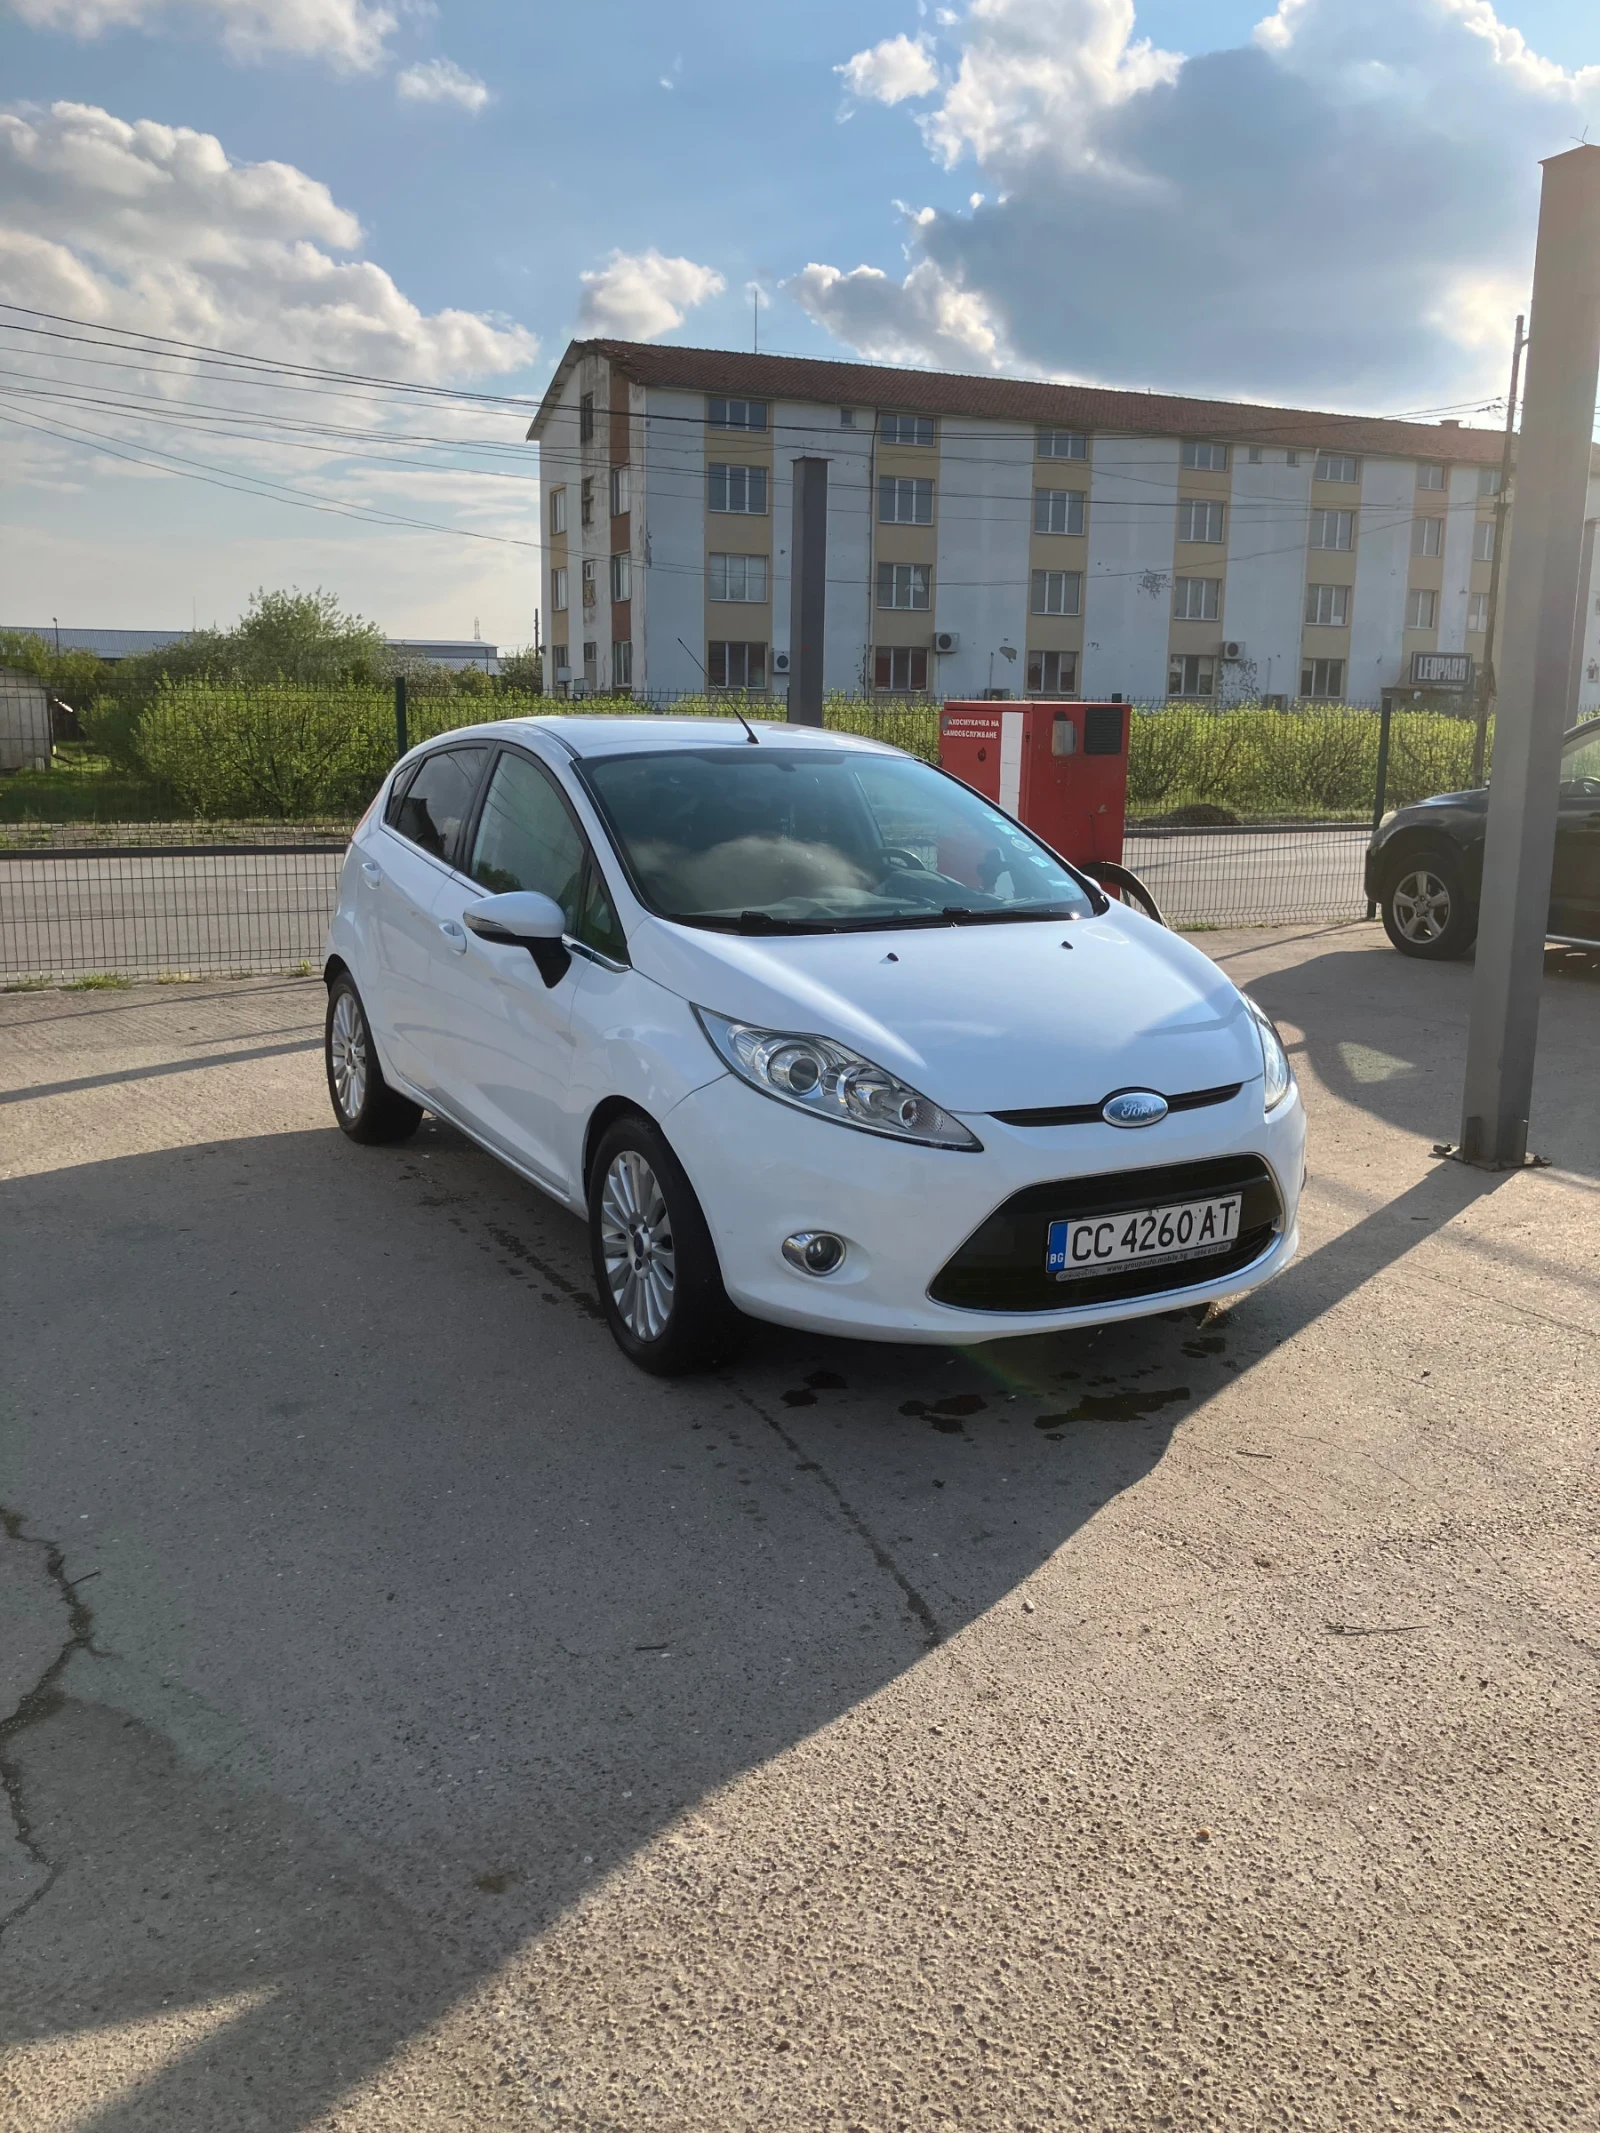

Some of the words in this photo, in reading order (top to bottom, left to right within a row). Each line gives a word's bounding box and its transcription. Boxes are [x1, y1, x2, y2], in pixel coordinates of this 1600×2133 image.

[945, 718, 990, 727] АХОСМУКАЧКА
[991, 719, 1000, 728] НА
[1121, 1100, 1157, 1119] Ford
[1072, 1222, 1115, 1262] CC
[1121, 1209, 1194, 1254] 4260
[1199, 1200, 1236, 1242] AT
[1049, 1252, 1065, 1265] BG
